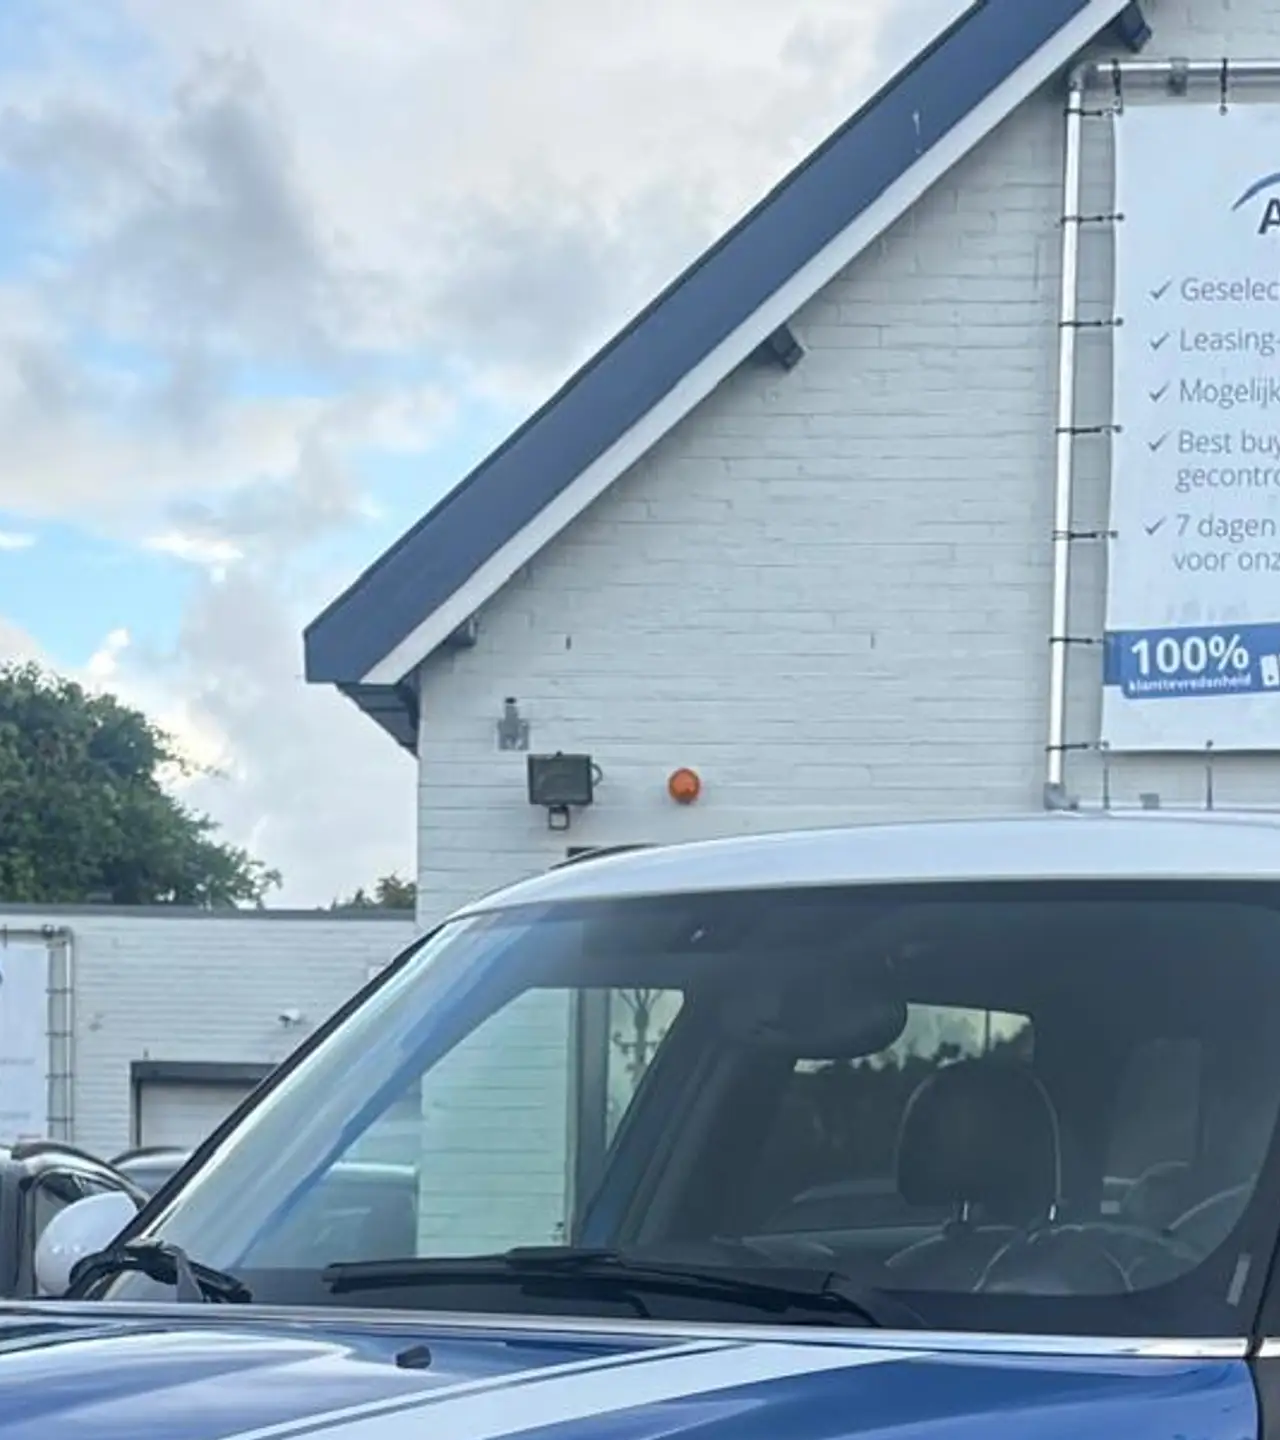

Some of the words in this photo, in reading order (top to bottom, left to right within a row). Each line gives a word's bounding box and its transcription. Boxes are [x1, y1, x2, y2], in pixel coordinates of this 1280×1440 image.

[1178, 431, 1231, 455] Best
[1176, 515, 1190, 538] 7
[1197, 513, 1276, 544] dagen
[1173, 550, 1229, 571] voor
[1132, 634, 1249, 675] 100%
